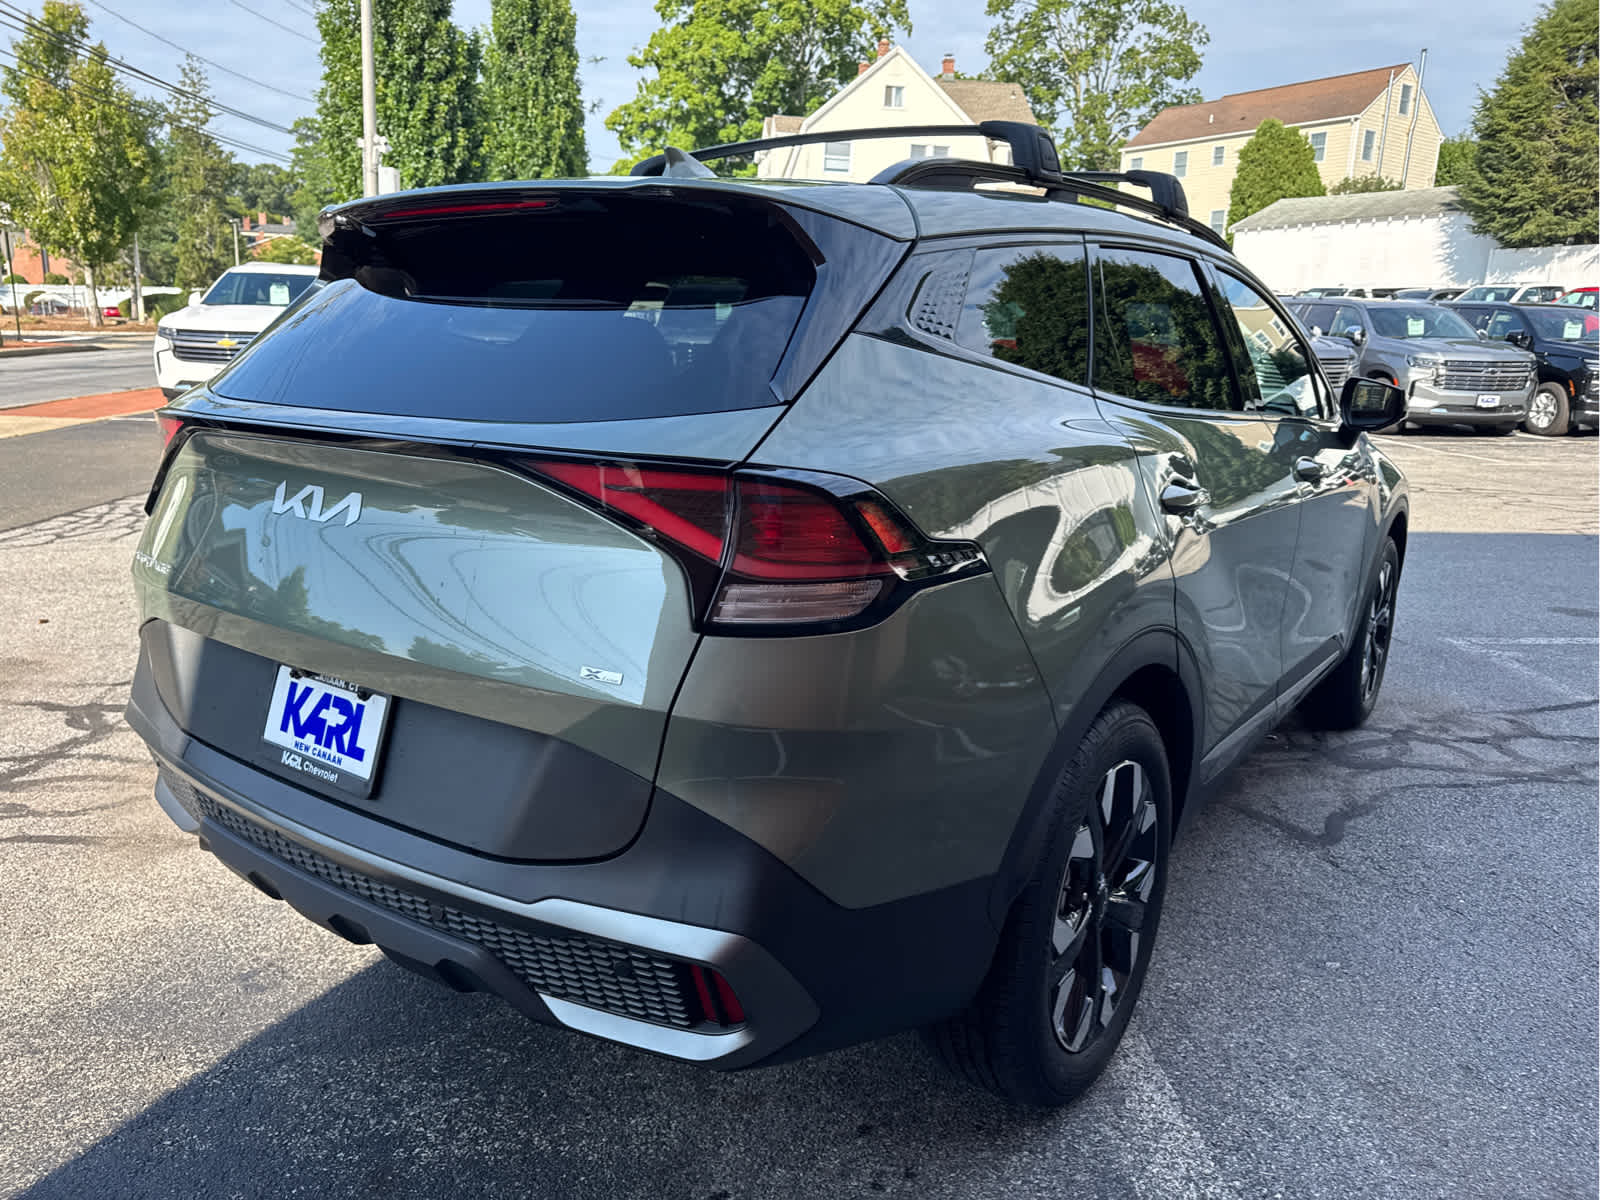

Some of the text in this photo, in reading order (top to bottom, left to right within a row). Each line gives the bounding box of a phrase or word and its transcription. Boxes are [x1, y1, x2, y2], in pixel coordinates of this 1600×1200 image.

[271, 480, 363, 527] KIA
[280, 681, 366, 762] KARL
[281, 750, 338, 783] KARL Chevrolet
[294, 740, 343, 766] NEW CANAAN
